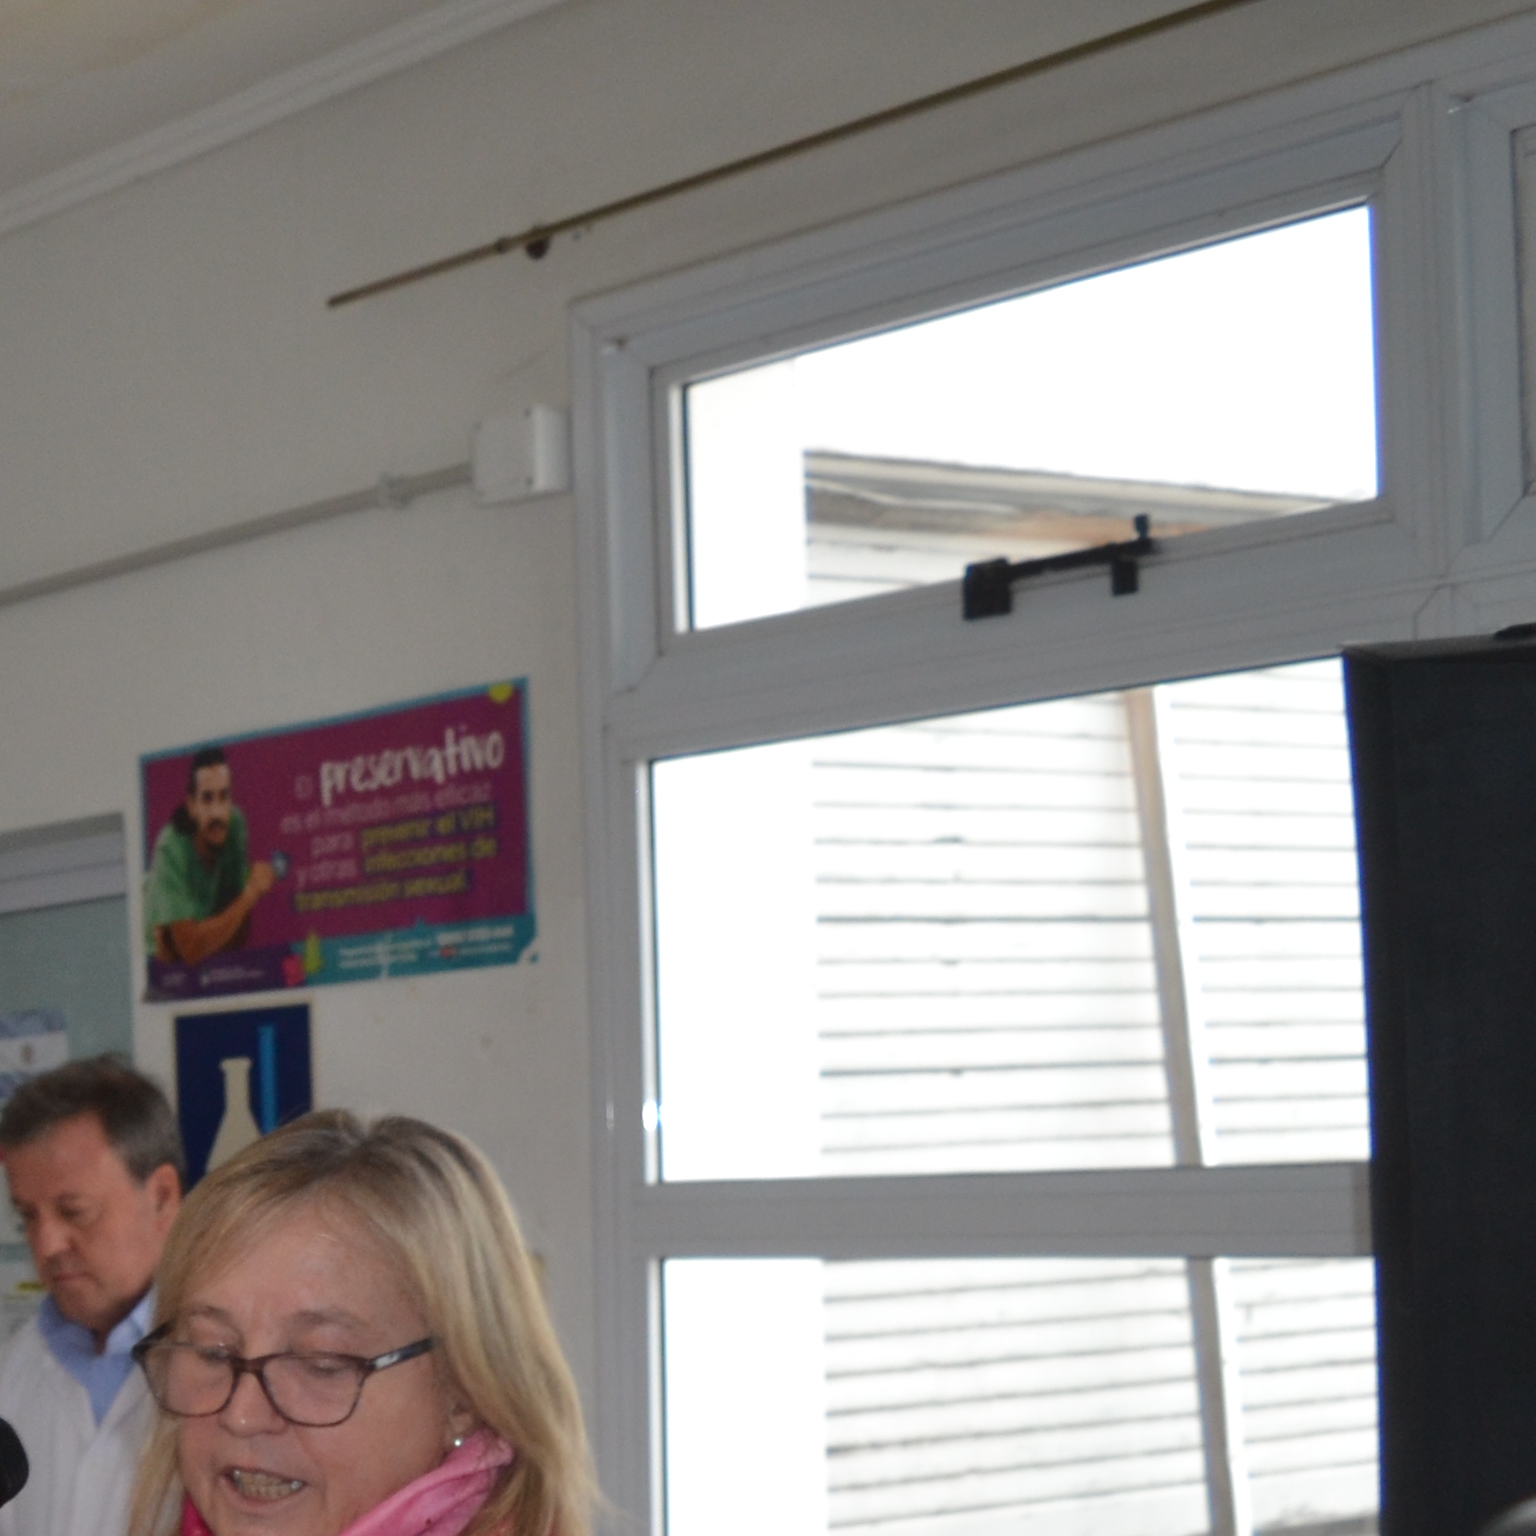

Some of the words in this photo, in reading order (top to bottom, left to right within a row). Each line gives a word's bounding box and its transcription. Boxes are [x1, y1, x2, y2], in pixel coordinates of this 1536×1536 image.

[320, 725, 505, 807] preservativo
[310, 831, 355, 858] para
[459, 806, 495, 830] VIH
[308, 858, 358, 883] otras
[363, 842, 467, 874] infecciones
[471, 836, 497, 859] de
